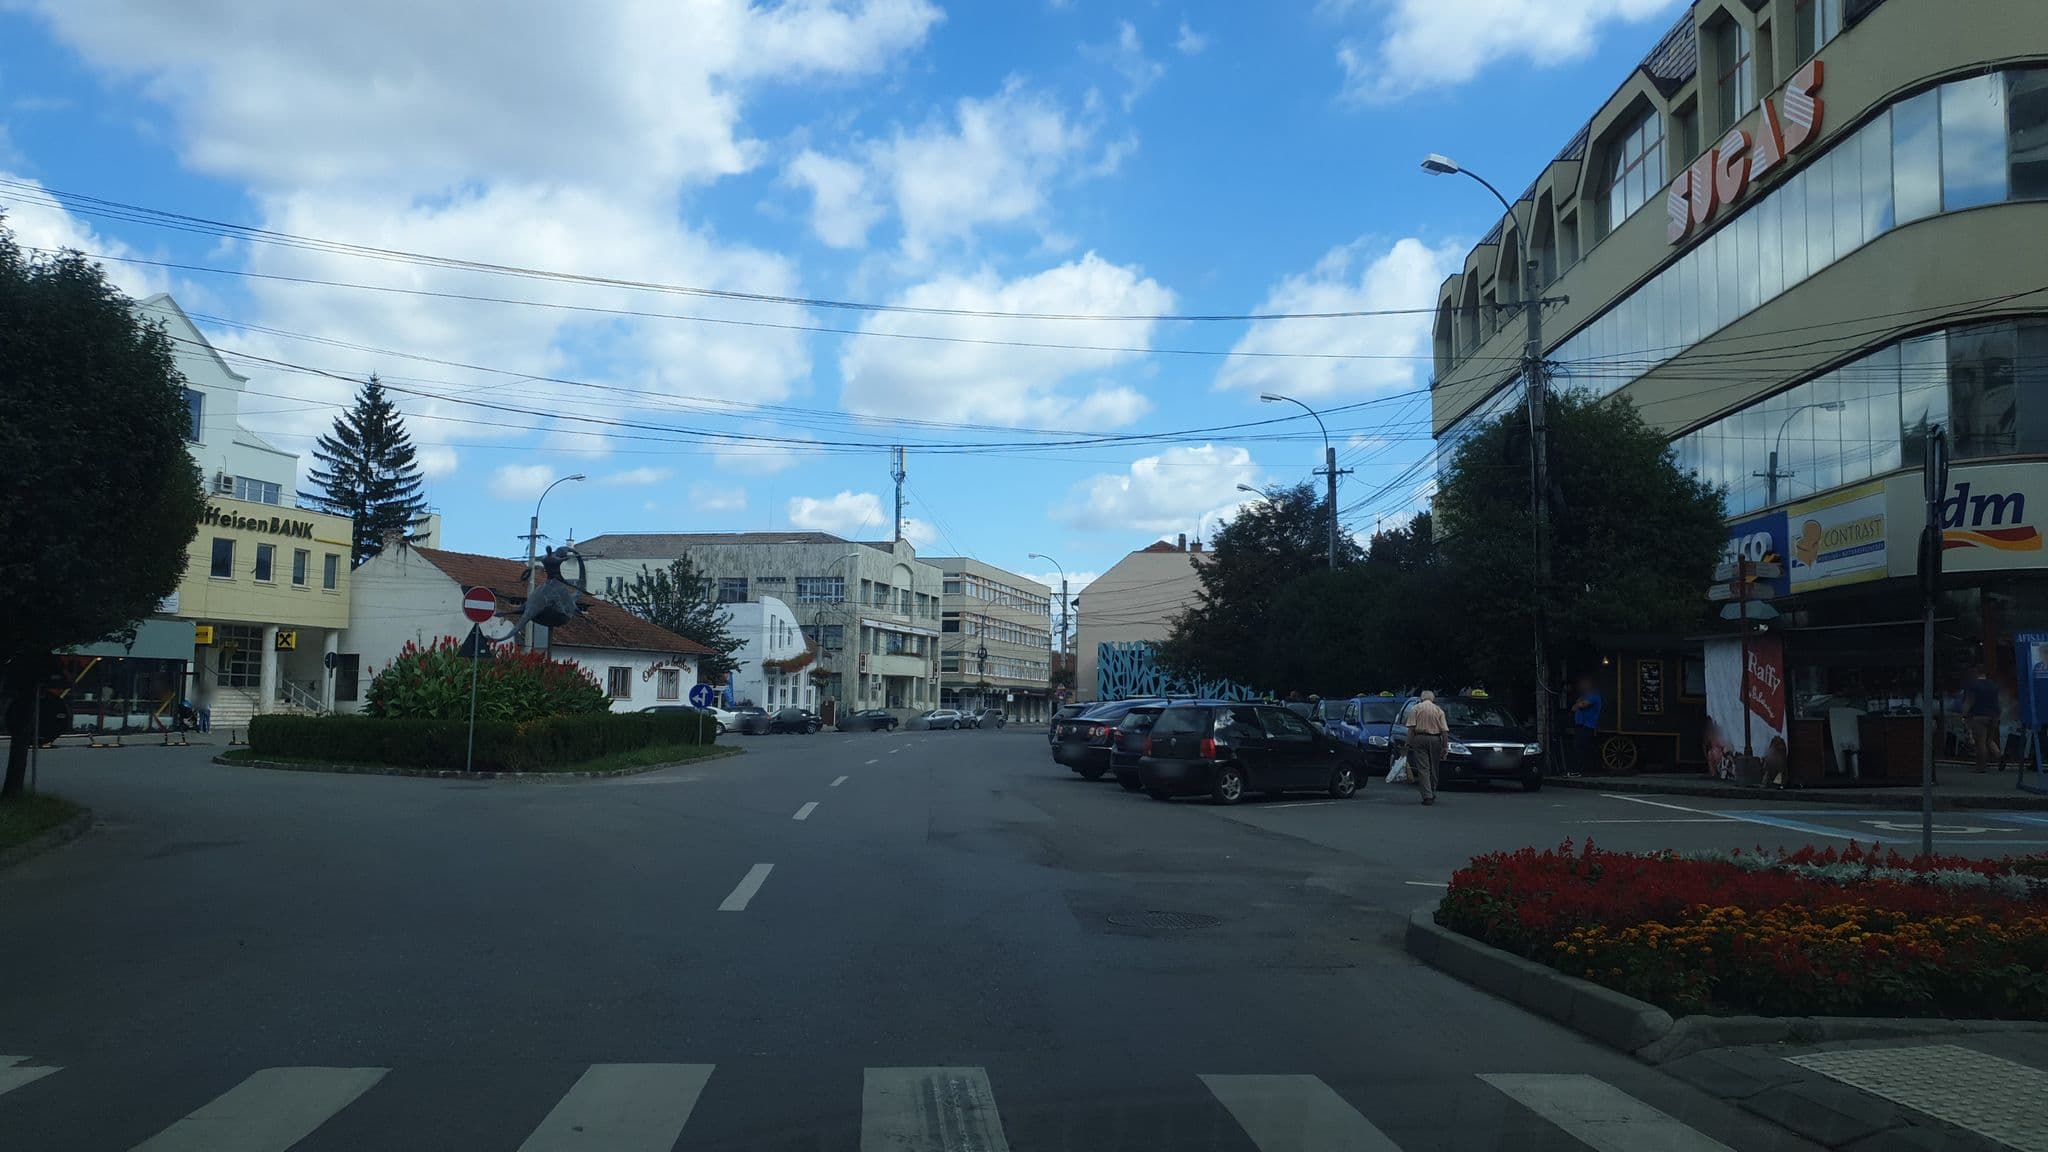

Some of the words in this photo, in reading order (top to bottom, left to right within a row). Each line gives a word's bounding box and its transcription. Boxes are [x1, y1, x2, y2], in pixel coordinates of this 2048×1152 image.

[1668, 59, 1824, 246] SUGAS
[199, 505, 314, 539] iffeisenBANK
[1943, 482, 2025, 530] dm
[1824, 518, 1881, 547] CONTRAST
[1747, 649, 1781, 696] Raffy
